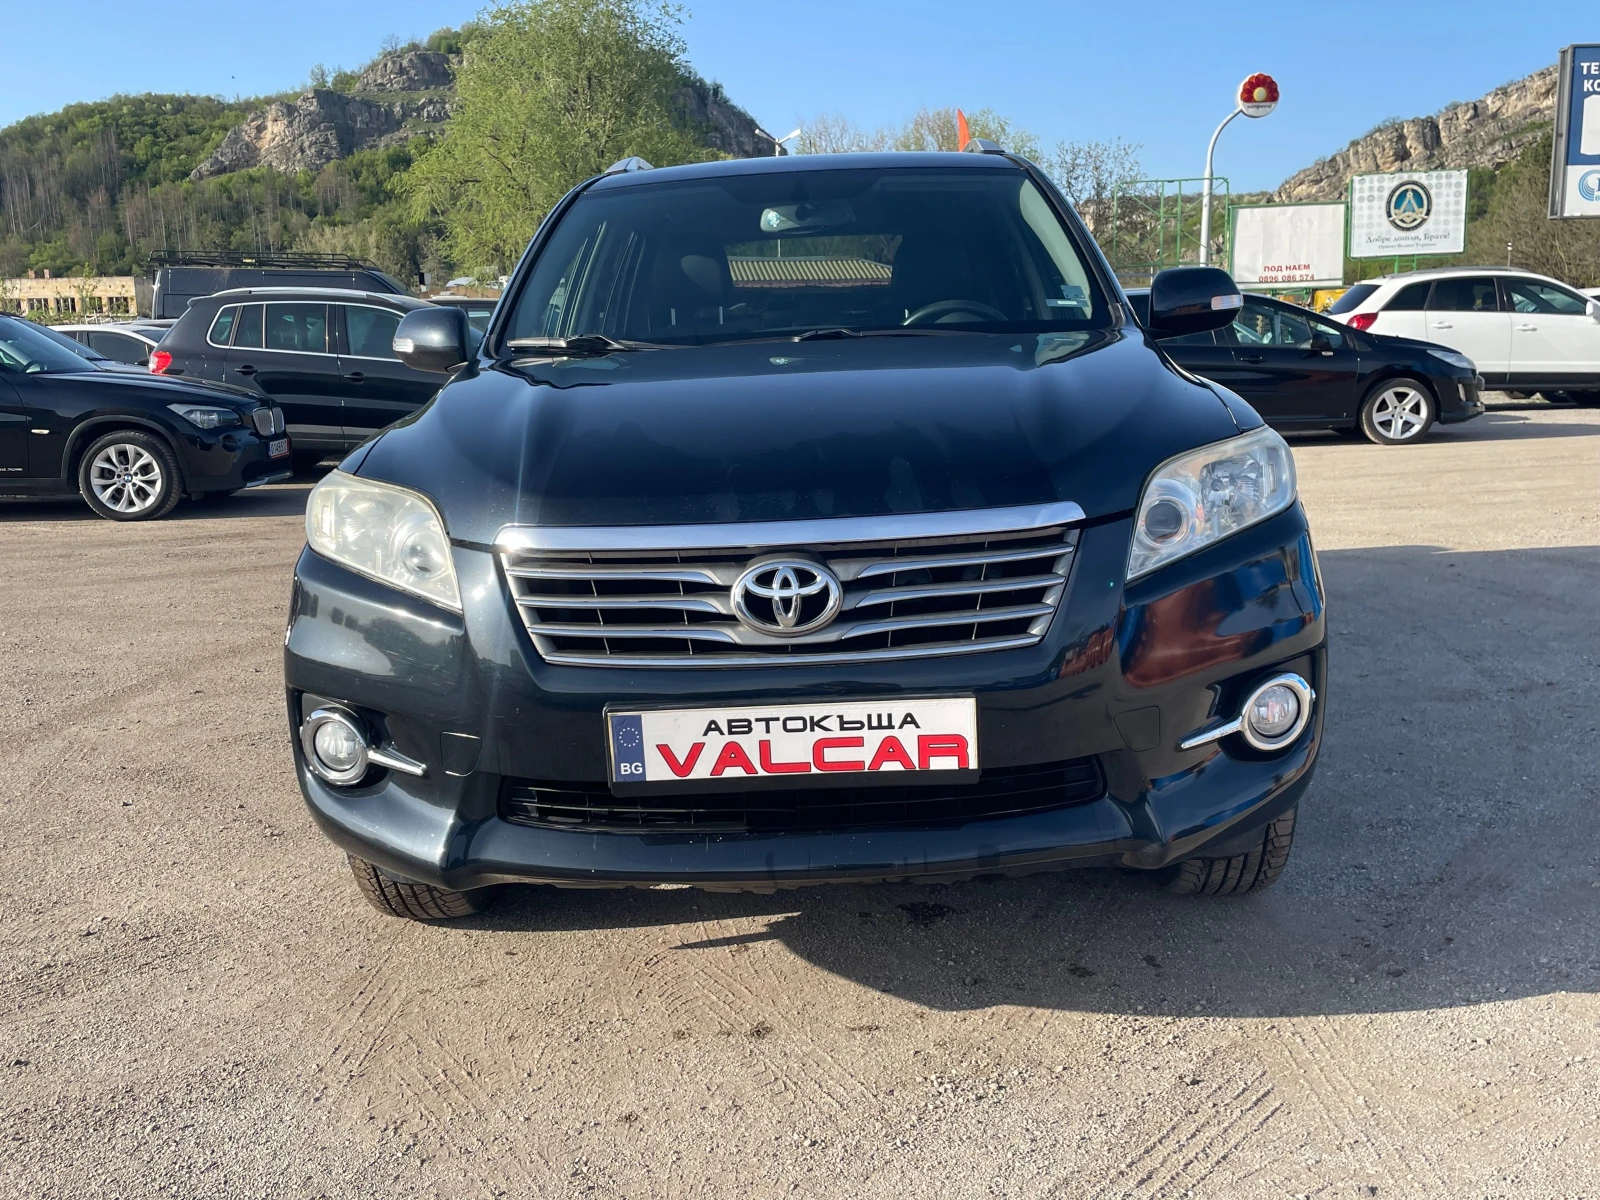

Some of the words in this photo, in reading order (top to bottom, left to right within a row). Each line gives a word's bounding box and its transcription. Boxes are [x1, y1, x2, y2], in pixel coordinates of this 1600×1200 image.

[702, 712, 921, 737] АВТОКЪЩА
[656, 733, 970, 778] VALCAR
[620, 762, 643, 775] BG
